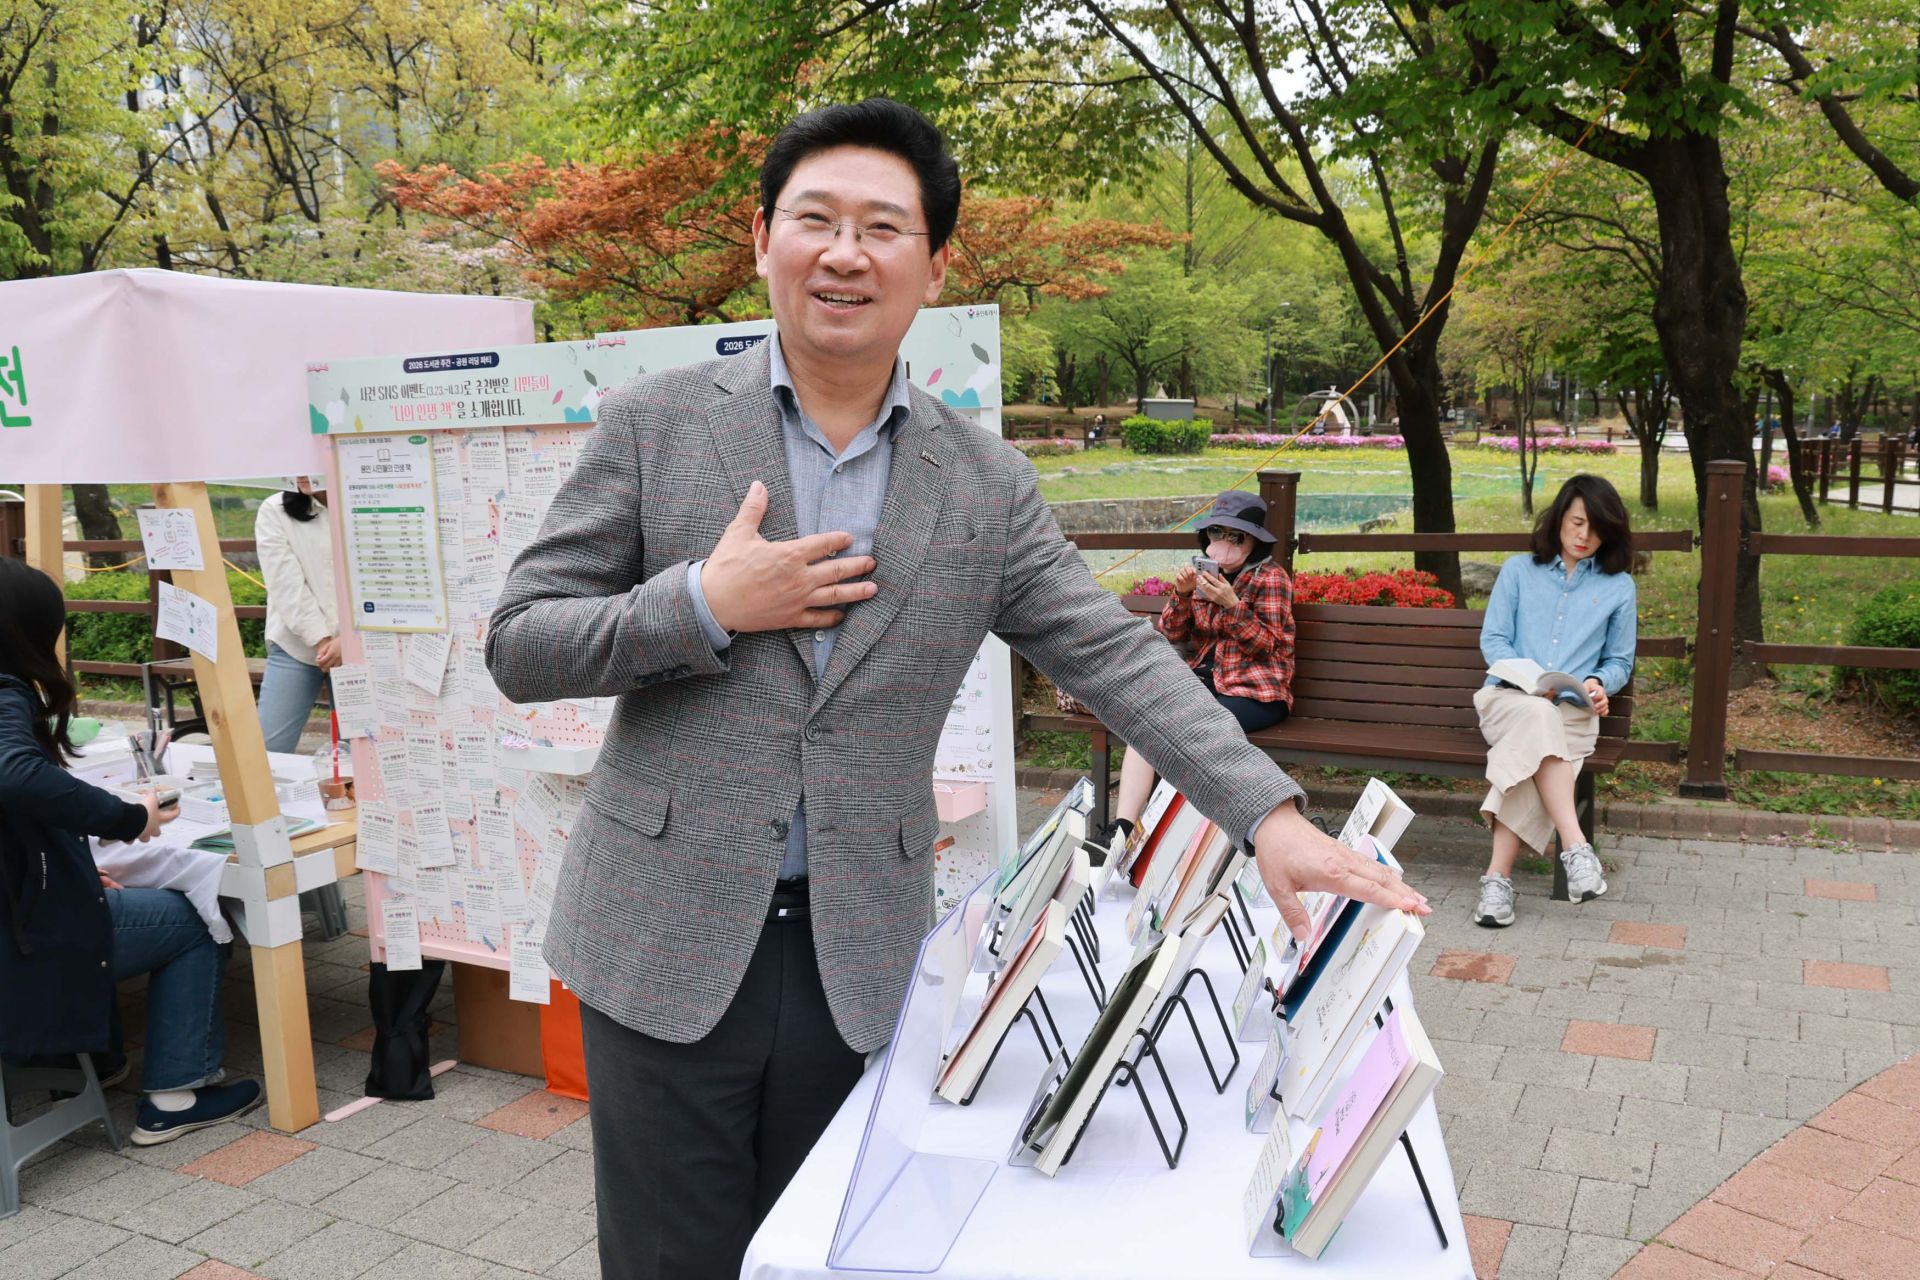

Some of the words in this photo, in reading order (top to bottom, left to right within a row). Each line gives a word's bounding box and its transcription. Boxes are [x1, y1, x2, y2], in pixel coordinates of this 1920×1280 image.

[724, 341, 743, 351] 2026
[408, 361, 423, 370] 2026
[424, 359, 439, 368] 도서관
[441, 358, 451, 367] 주간
[456, 357, 467, 367] 공원
[480, 355, 492, 364] 파티
[360, 386, 376, 401] 사전
[378, 384, 398, 400] SNS
[475, 376, 509, 395] 추천받은
[513, 374, 549, 393] 시민들이
[416, 402, 437, 421] 인생
[470, 398, 525, 418] 소개합니다.
